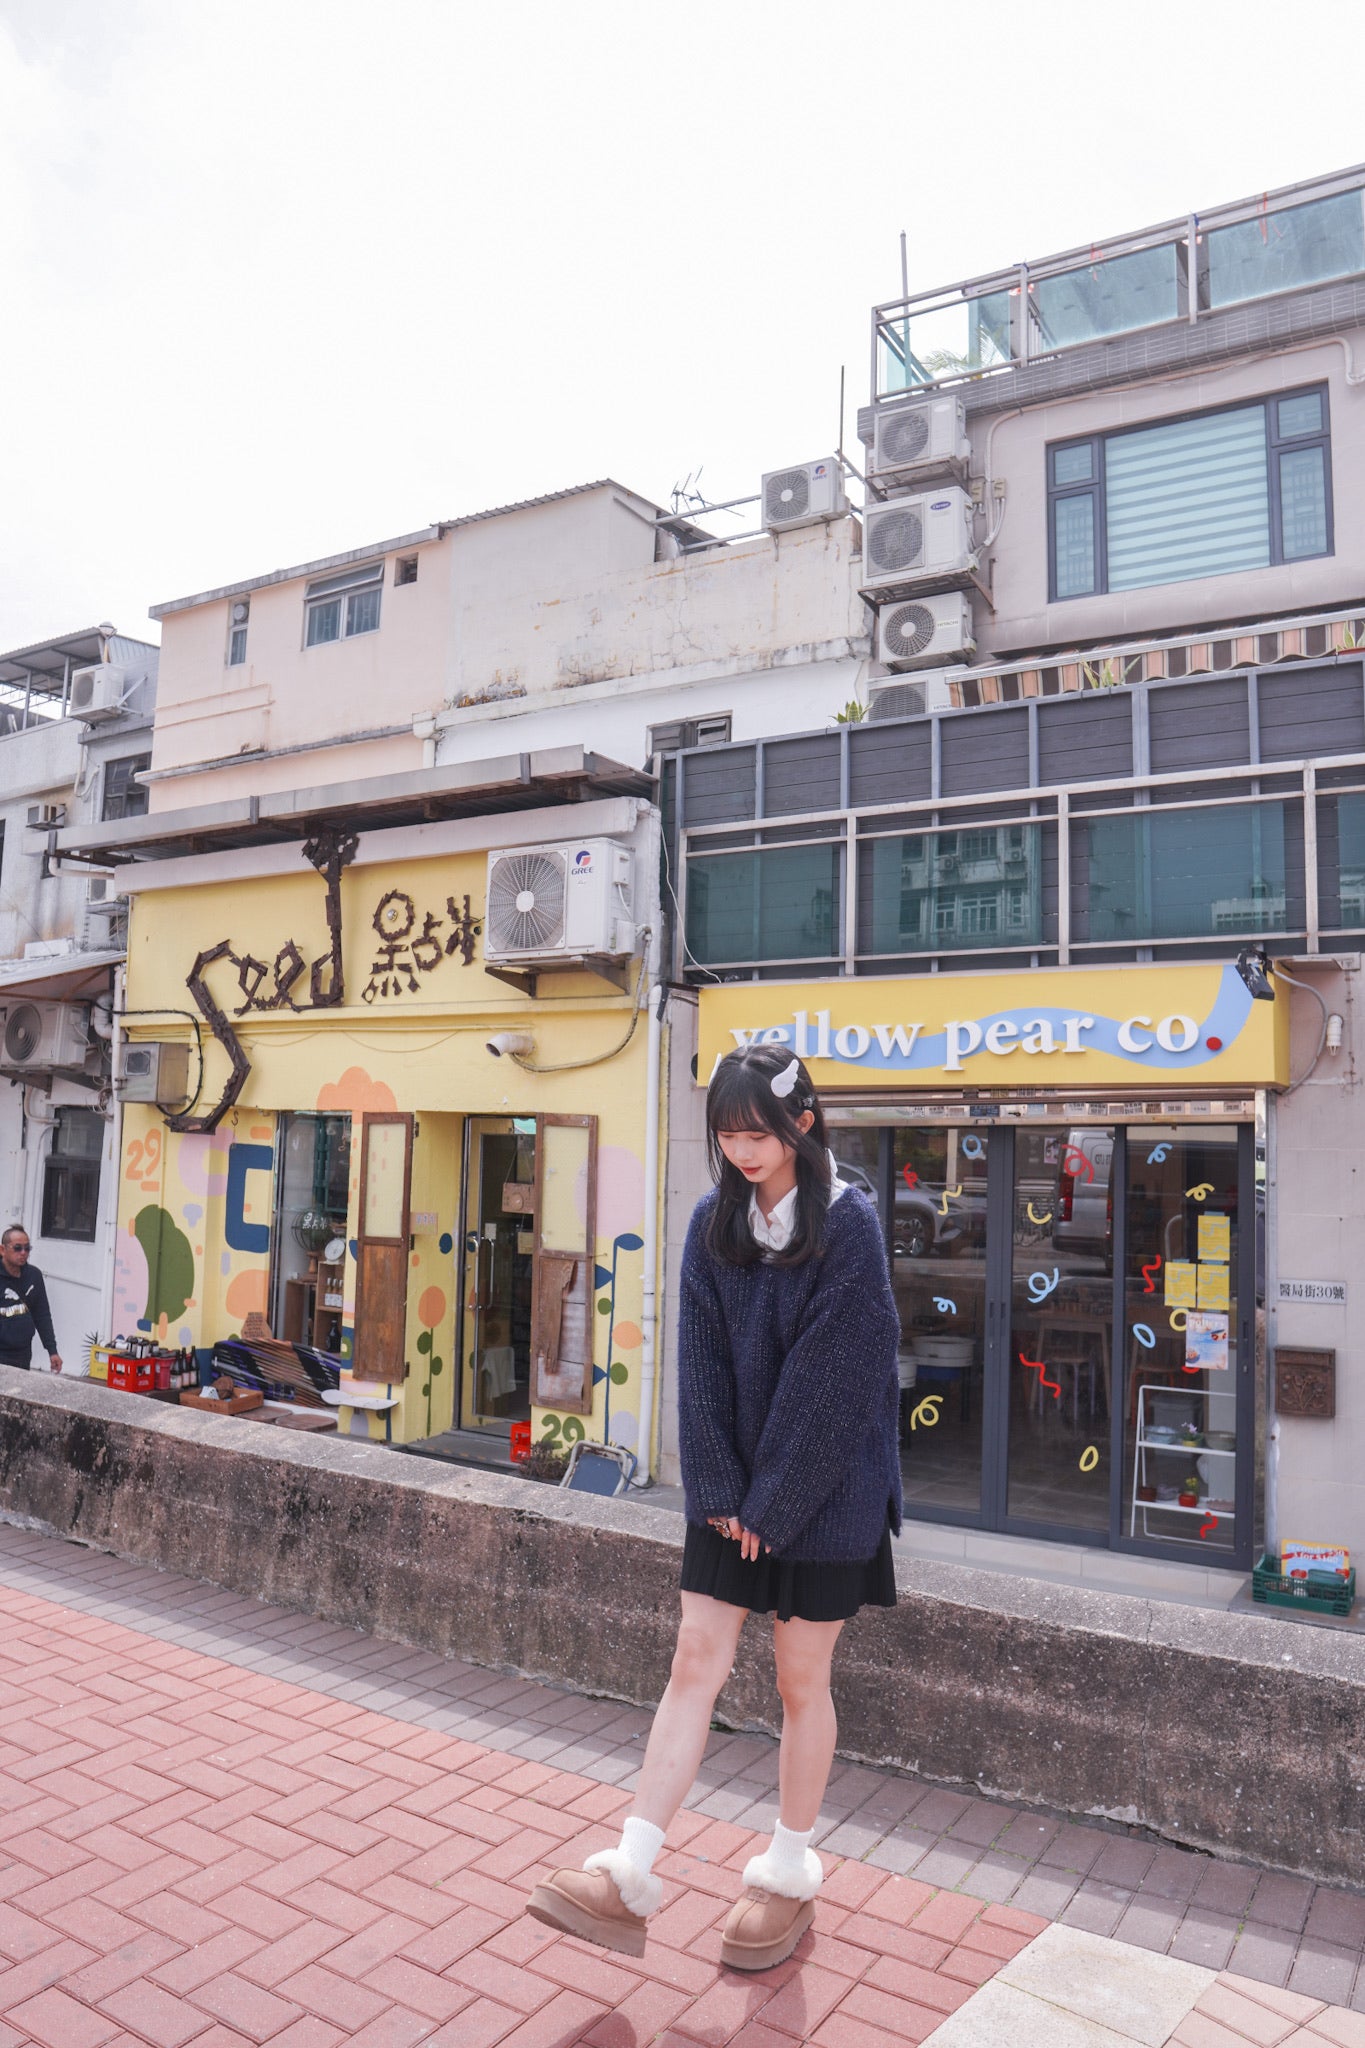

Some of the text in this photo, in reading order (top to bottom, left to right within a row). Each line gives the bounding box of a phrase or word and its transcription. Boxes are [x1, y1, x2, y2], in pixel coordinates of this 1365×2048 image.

[571, 866, 595, 876] GREE
[941, 1016, 1094, 1072] pear
[1117, 1014, 1224, 1054] co.
[125, 1127, 162, 1181] 29
[1279, 1283, 1345, 1300] 醫局街30號
[541, 1413, 586, 1457] 29
